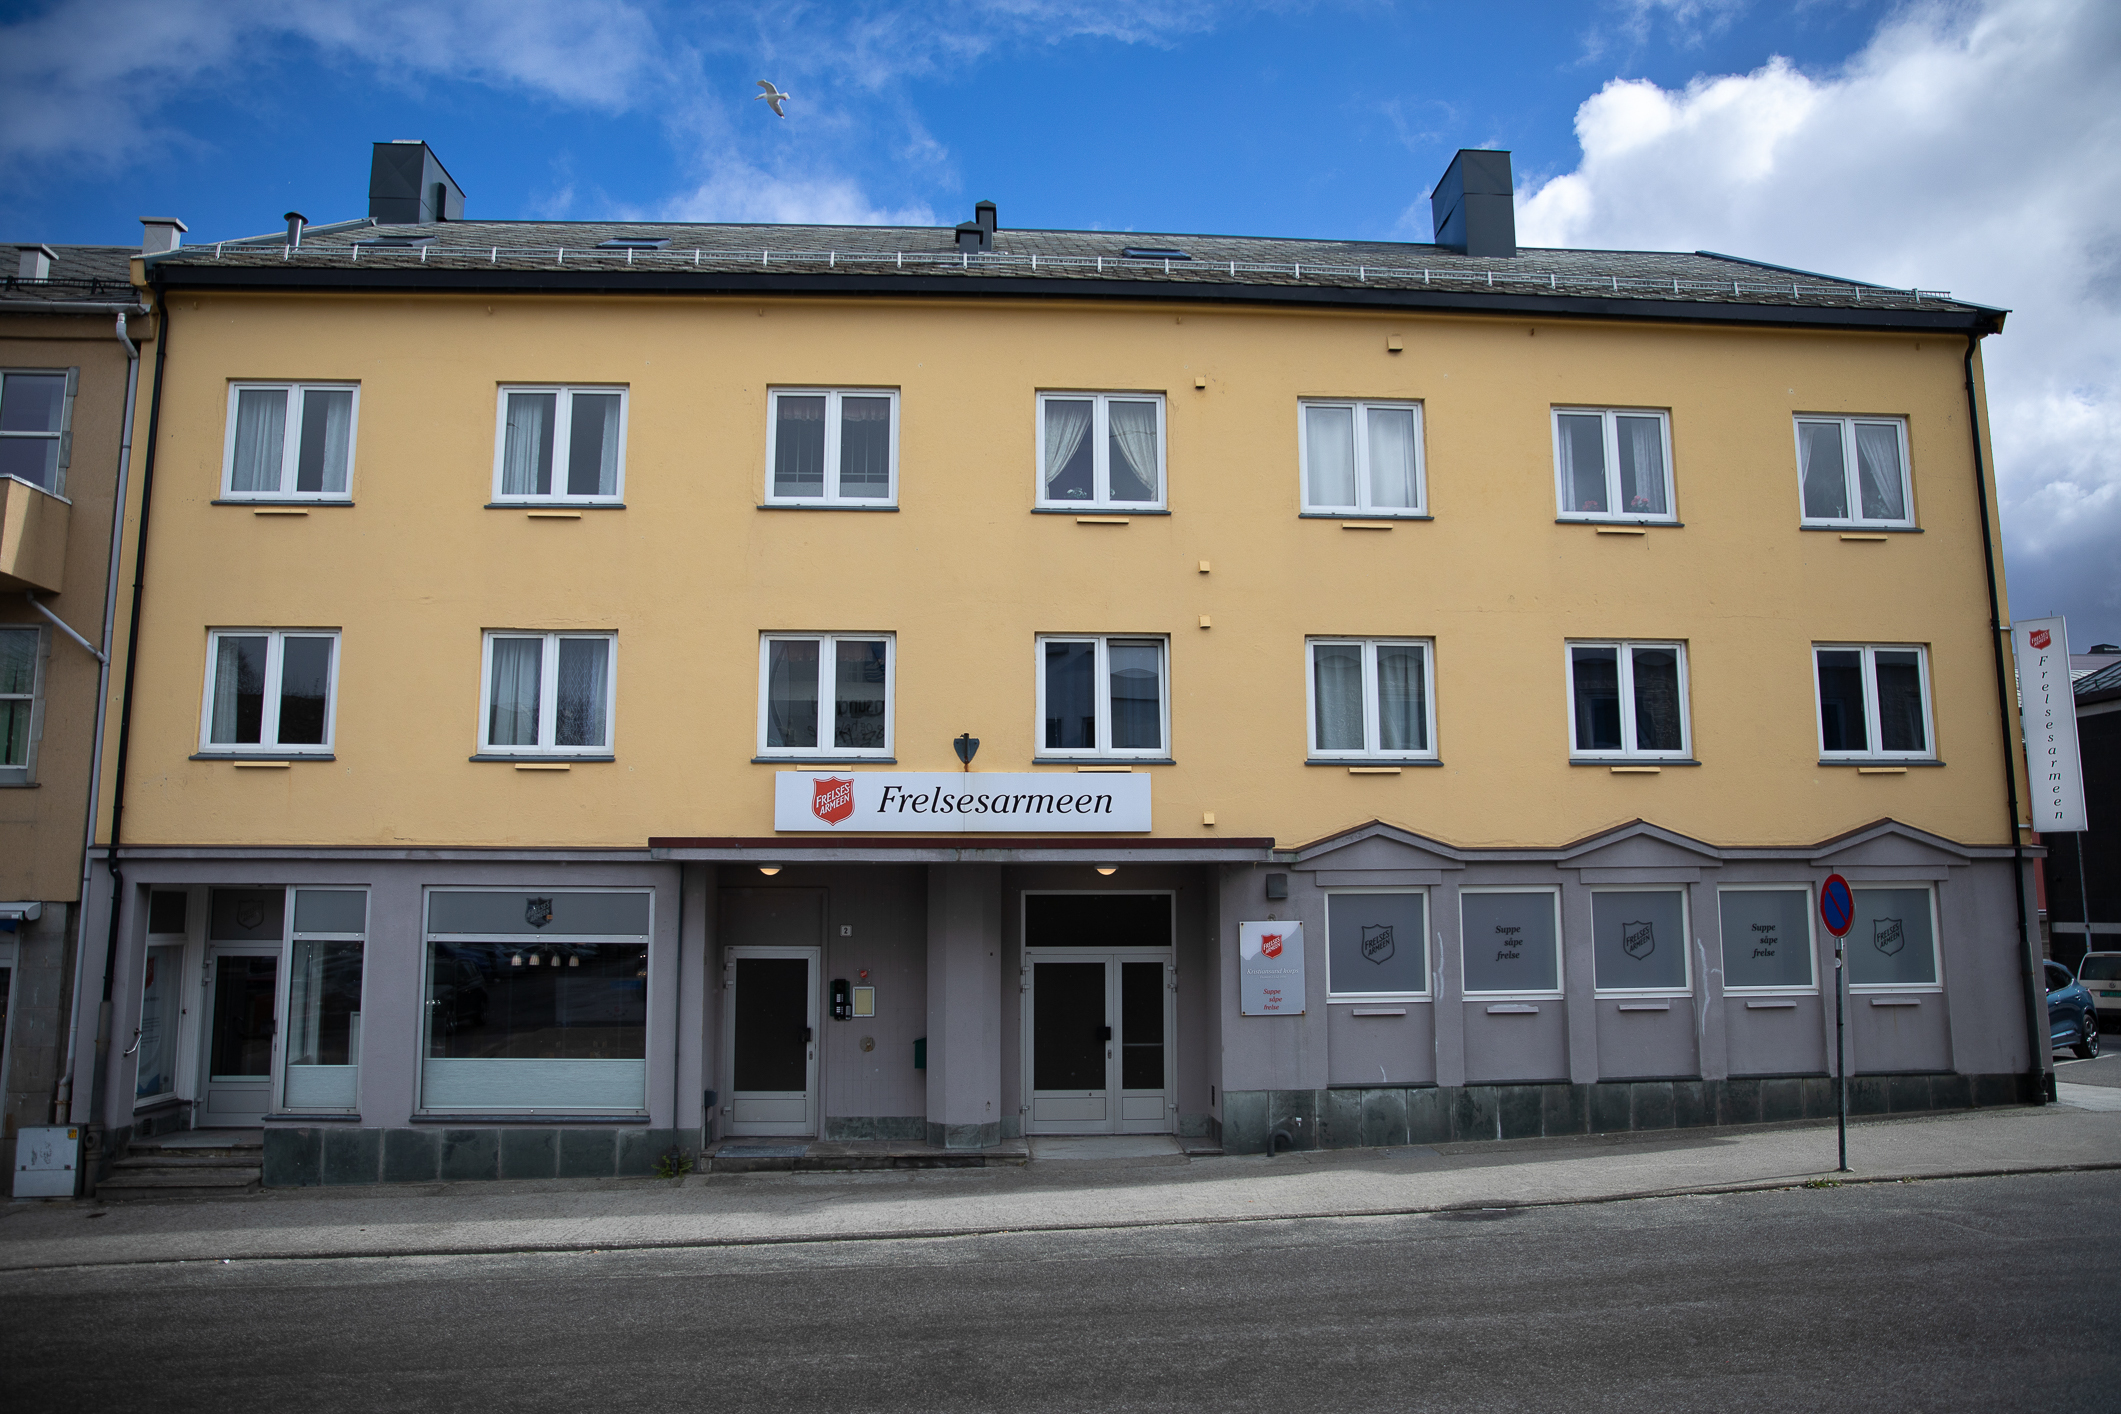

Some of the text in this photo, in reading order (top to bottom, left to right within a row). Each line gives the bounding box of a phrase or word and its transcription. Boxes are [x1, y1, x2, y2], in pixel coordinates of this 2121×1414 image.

[2038, 655, 2064, 819] Frelsesarmeen
[819, 793, 850, 816] ARMEEN
[877, 785, 1113, 815] Frelsesarmeen
[1496, 925, 1520, 935] Suppe
[1751, 923, 1776, 933] Suppe
[1504, 937, 1523, 948] såpe
[1629, 934, 1650, 952] ARMEEN
[1759, 935, 1778, 946] såpe
[1879, 930, 1900, 949] ARMEEN
[1368, 938, 1391, 956] ARMEEN
[1496, 951, 1520, 961] frelse
[1752, 948, 1776, 959] frelse
[1263, 988, 1280, 996] Suppe
